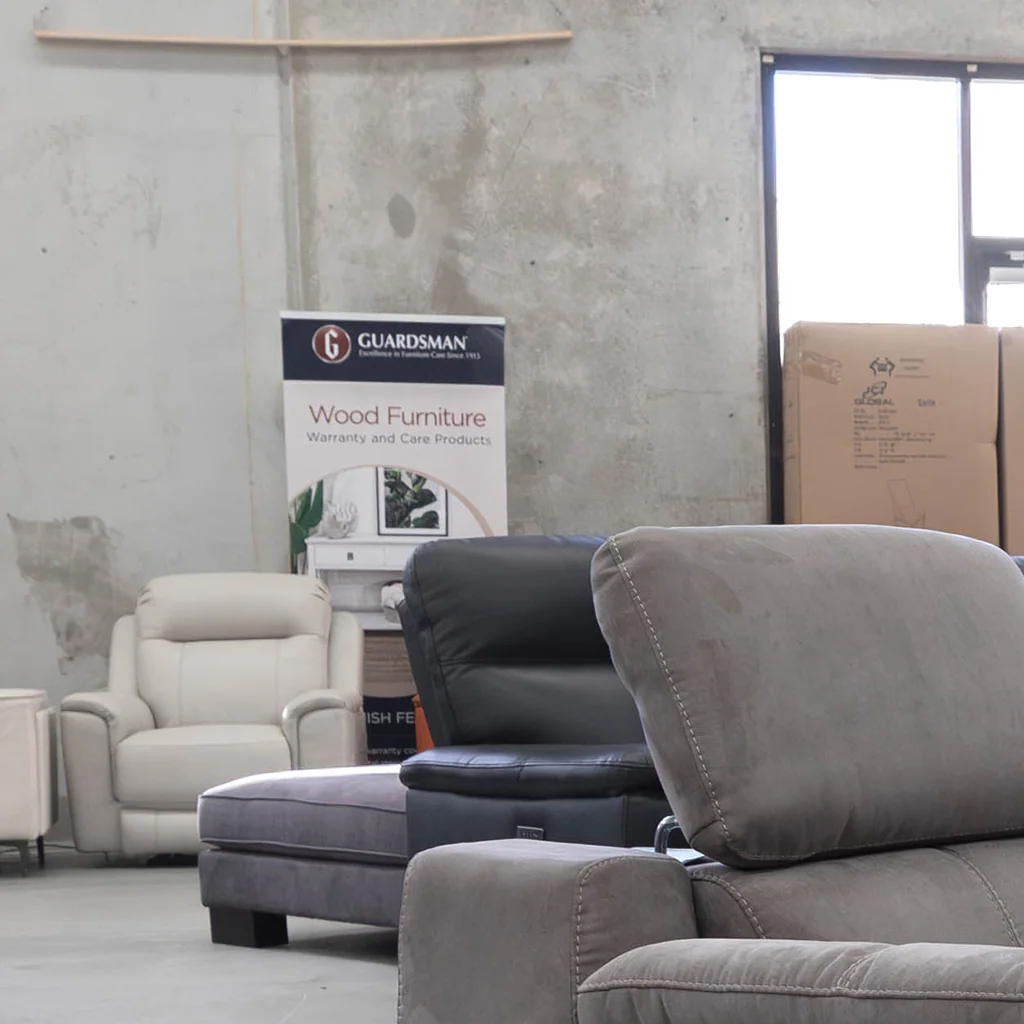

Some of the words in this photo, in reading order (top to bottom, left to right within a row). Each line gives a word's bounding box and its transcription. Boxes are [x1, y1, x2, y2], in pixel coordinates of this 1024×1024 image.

[358, 332, 467, 350] GUARDSMAN
[401, 350, 430, 359] Furniture
[430, 351, 445, 359] Care
[308, 404, 379, 425] Wood
[387, 406, 487, 427] Furniture
[307, 432, 367, 446] Warranty
[371, 432, 395, 444] and
[400, 433, 430, 445] Care
[435, 433, 492, 446] Products
